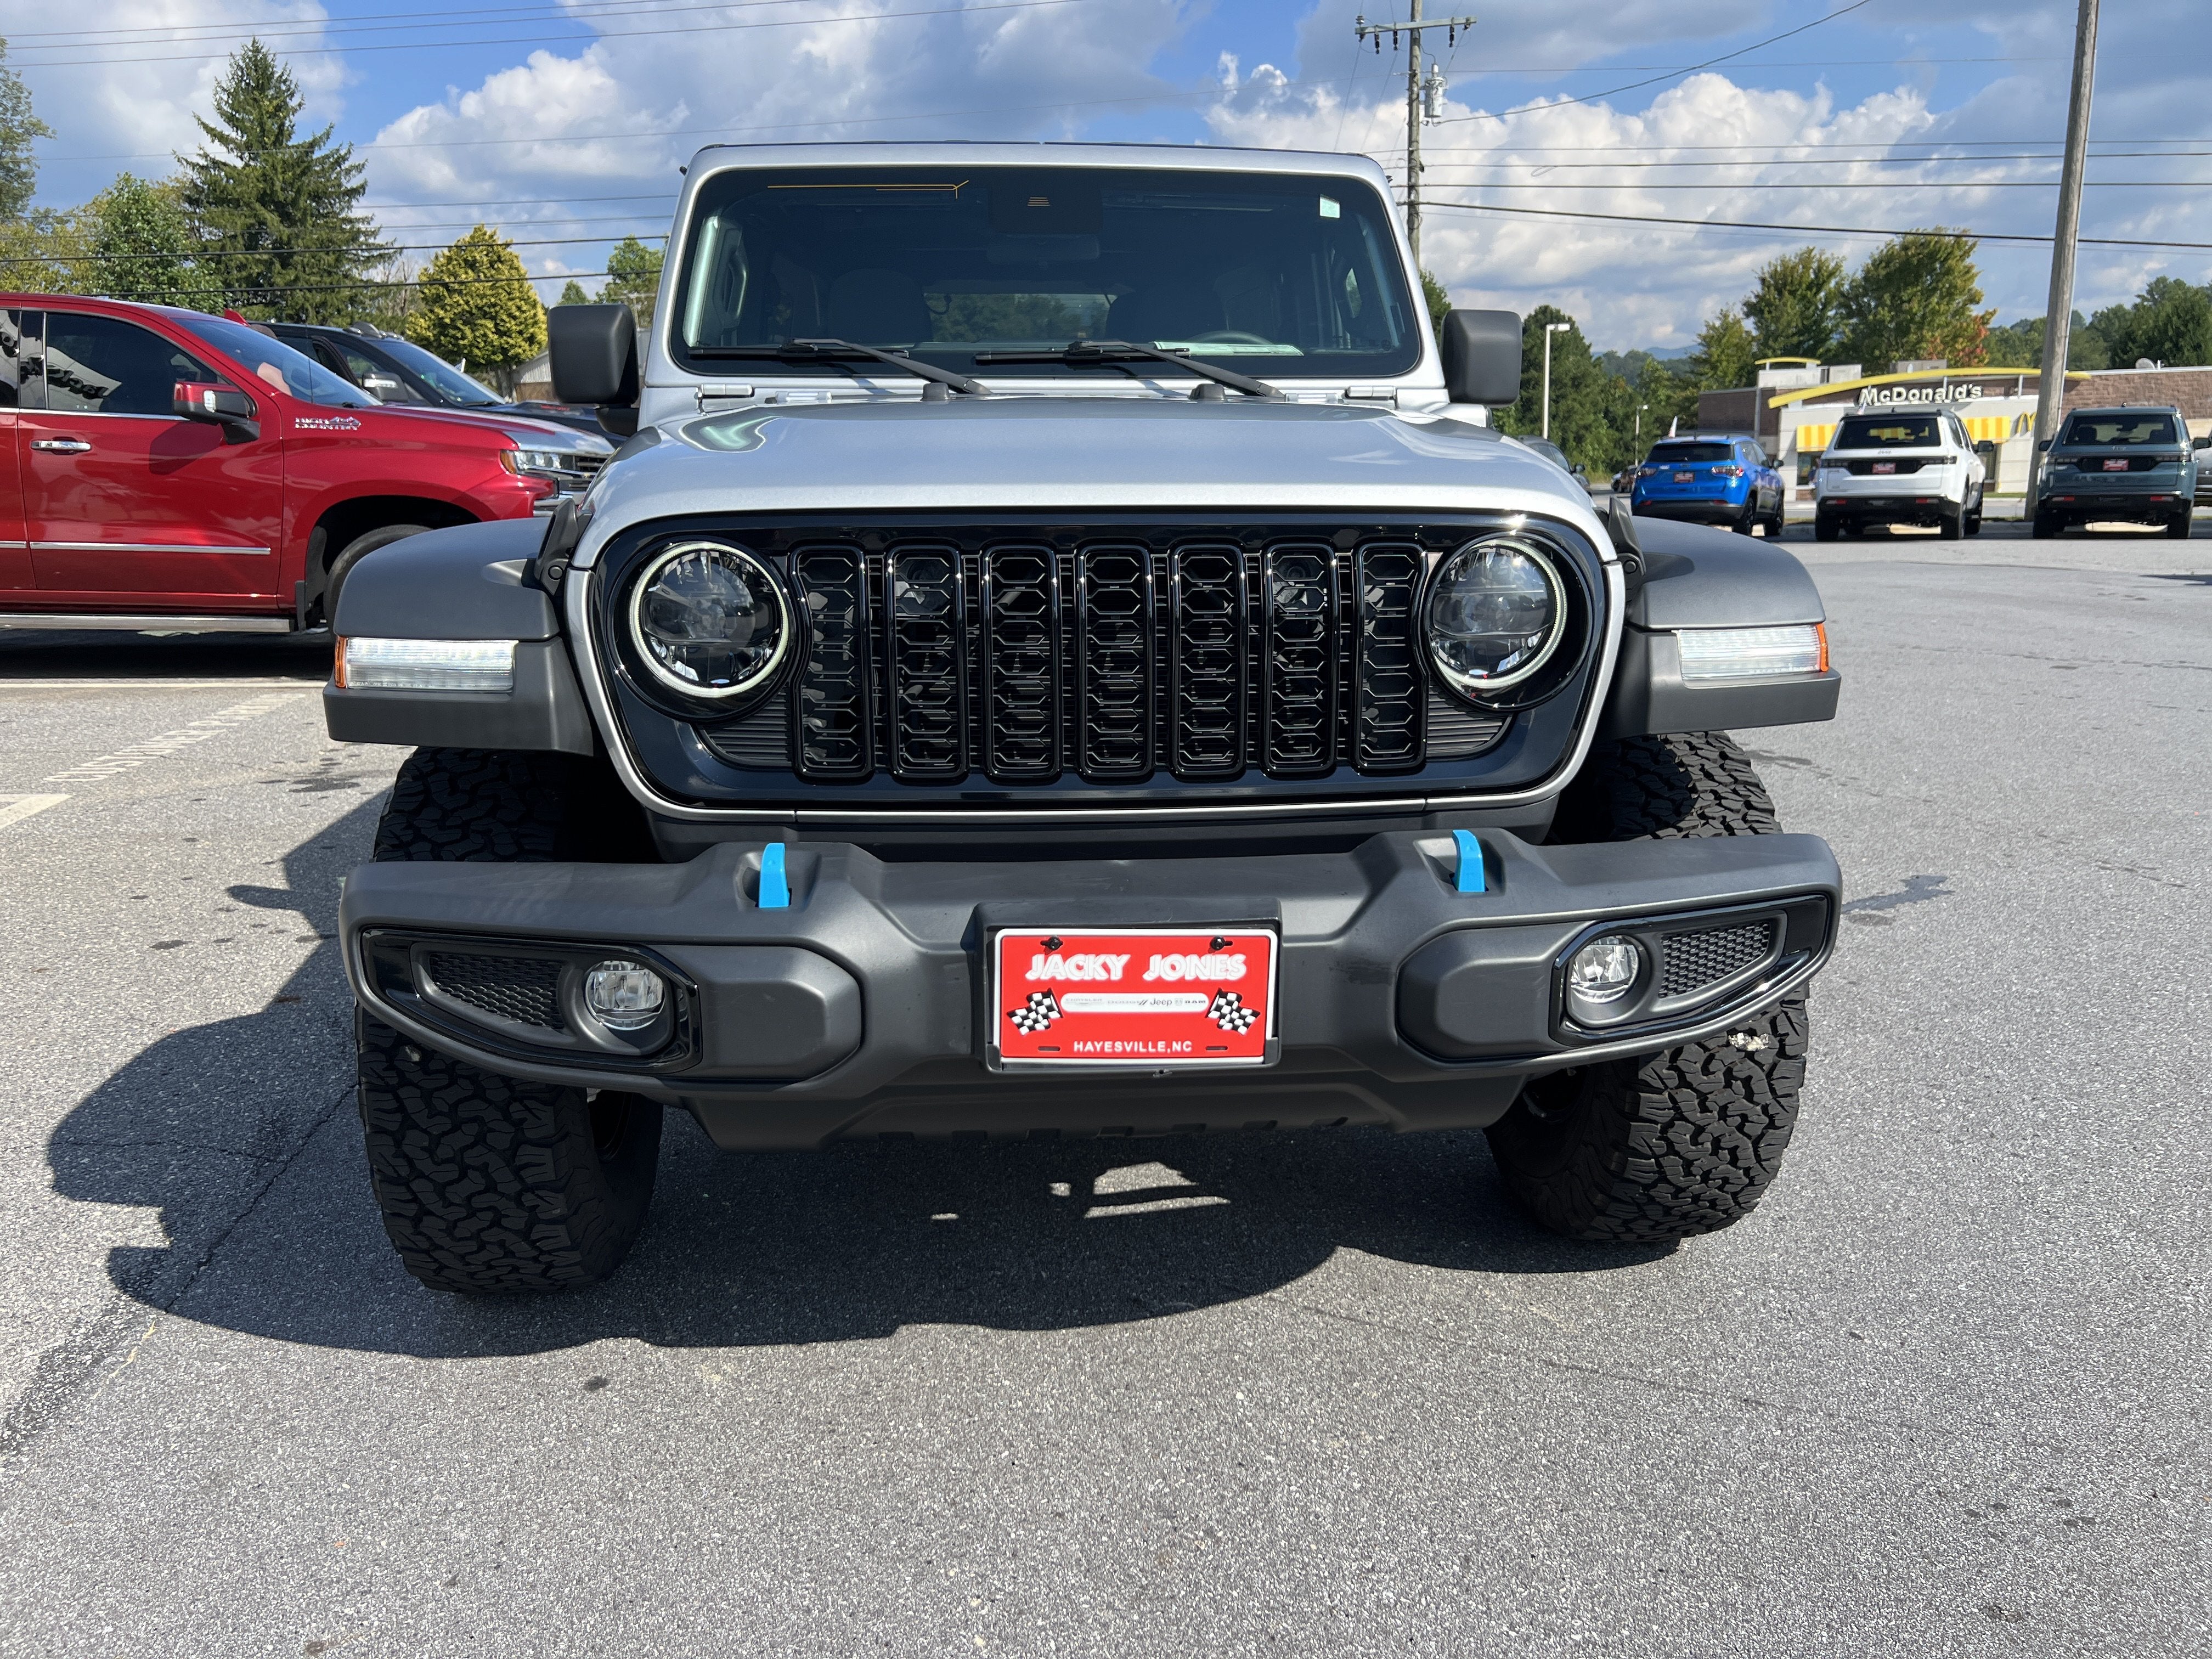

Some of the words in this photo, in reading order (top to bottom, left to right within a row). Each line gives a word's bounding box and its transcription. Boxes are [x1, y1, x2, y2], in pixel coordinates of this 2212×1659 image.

[1858, 383, 1983, 407] McDonald's
[42, 729, 226, 781] CUSTOMER
[1024, 953, 1131, 980] JACKY
[1142, 953, 1247, 981] JONES
[1150, 997, 1172, 1006] Jeep
